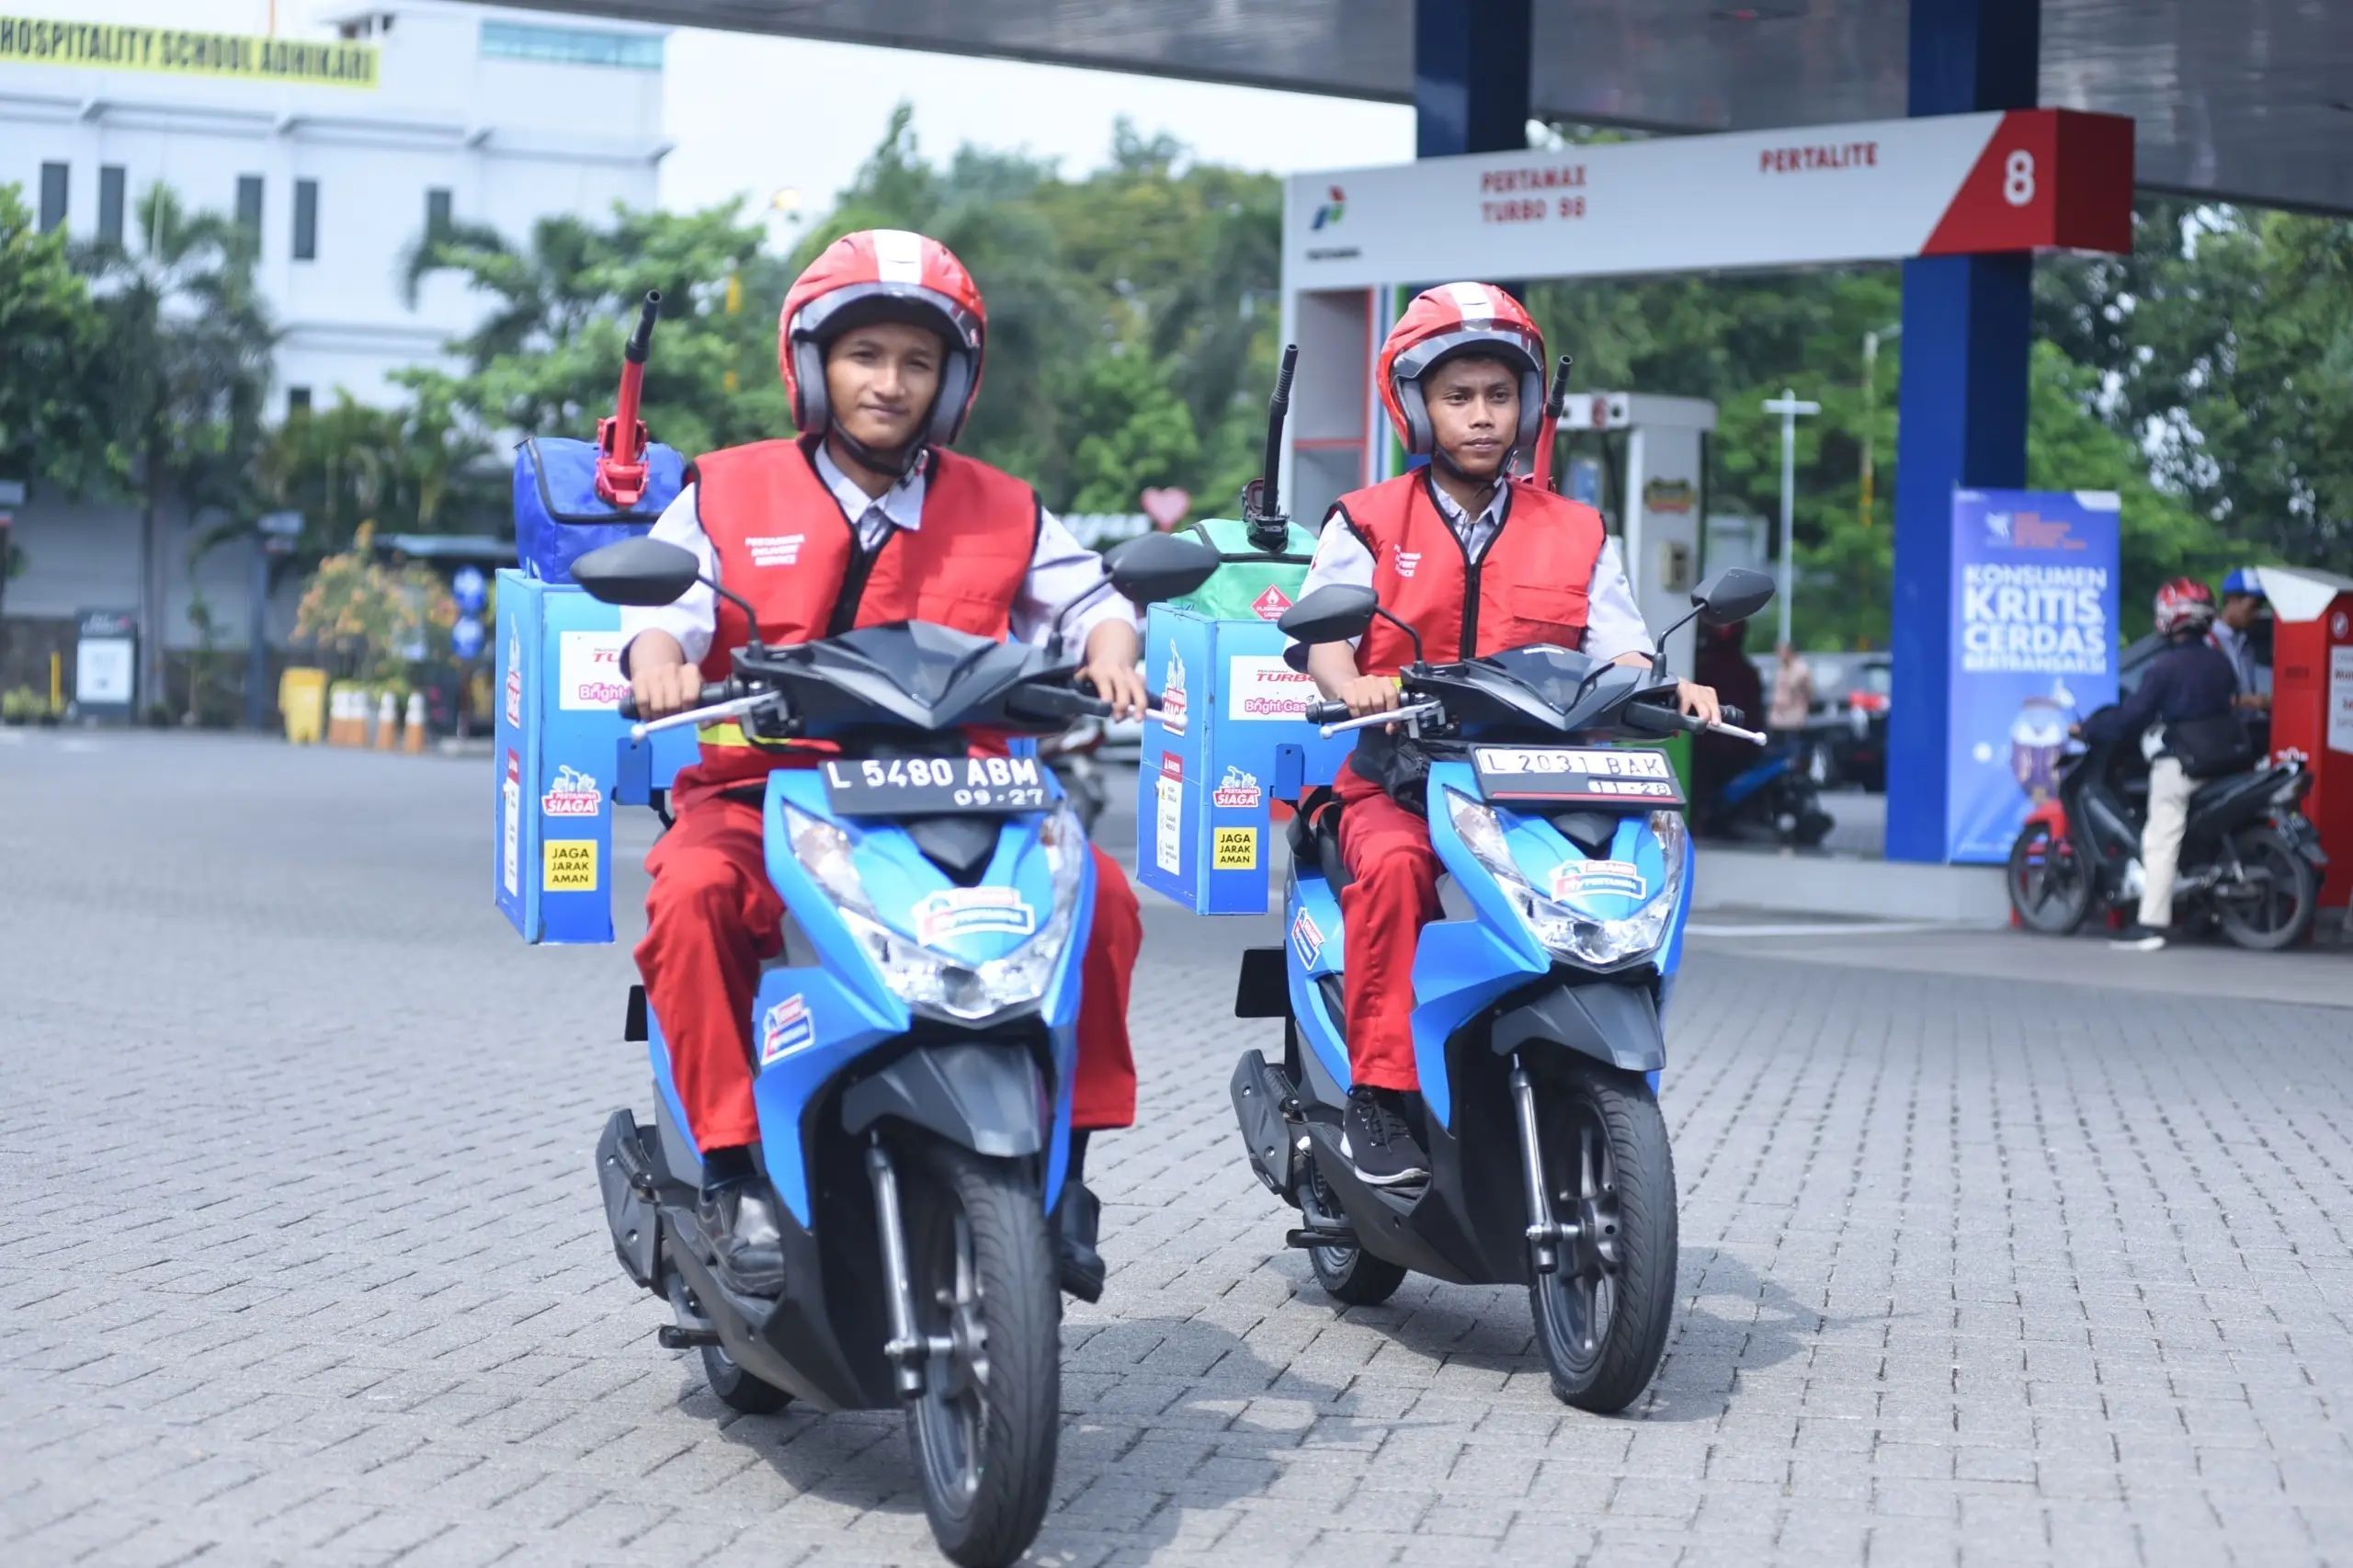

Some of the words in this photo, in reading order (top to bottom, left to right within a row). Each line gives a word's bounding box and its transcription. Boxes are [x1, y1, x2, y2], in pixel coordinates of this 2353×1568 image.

[1, 17, 152, 65] HOSPITALITY
[161, 29, 252, 72] SCHOOL
[1759, 142, 1879, 173] PERTALITE
[1481, 165, 1586, 193] PERTAMAX
[2004, 149, 2036, 207] 8
[1481, 200, 1547, 223] TURBO
[1963, 563, 2107, 588] KONSUMEN
[1963, 622, 2107, 655] CERDAS
[1245, 698, 1282, 715] Bright
[1283, 699, 1307, 713] Gas
[827, 761, 852, 789] L
[862, 758, 954, 788] 5480
[967, 758, 1039, 787] ABM
[1487, 753, 1506, 771] L
[1518, 754, 1590, 774] 2031
[1606, 756, 1664, 776] BAK
[547, 799, 595, 813] SIAGA
[1217, 793, 1256, 806] SIAGA
[1220, 834, 1252, 844] JAGA
[551, 847, 589, 859] JAGA
[1220, 845, 1252, 854] JARAK
[551, 861, 589, 871] JARAK
[1220, 856, 1252, 864] AMAN
[551, 874, 589, 883] AMAN
